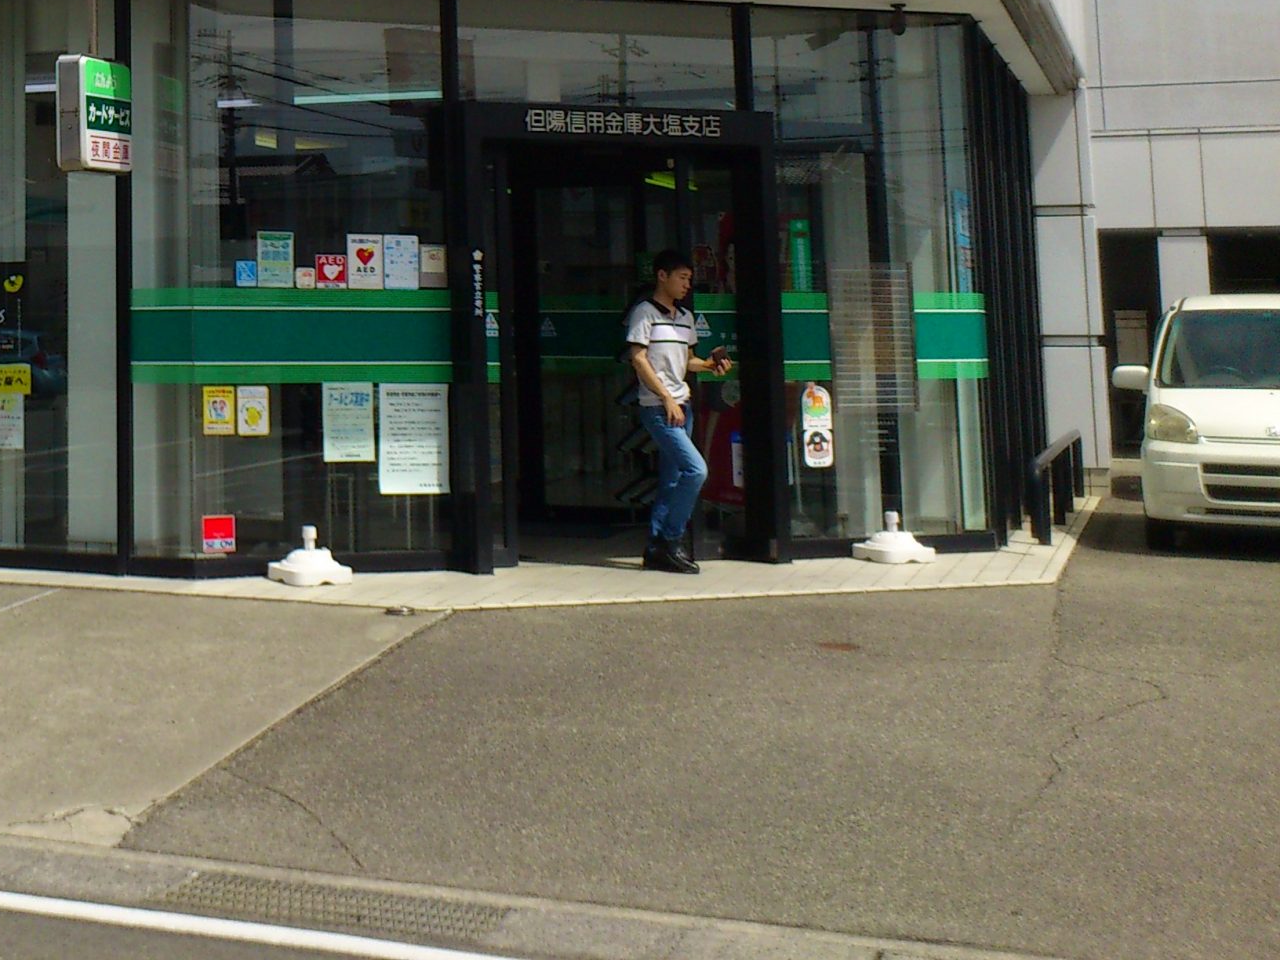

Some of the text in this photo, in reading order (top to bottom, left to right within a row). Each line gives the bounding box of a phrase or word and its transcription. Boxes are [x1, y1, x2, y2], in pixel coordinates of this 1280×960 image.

[88, 103, 131, 127] カードサービス
[525, 109, 721, 137] 但陽信用金庫大塩支店
[91, 141, 130, 160] 夜間金庫
[319, 255, 345, 265] AED
